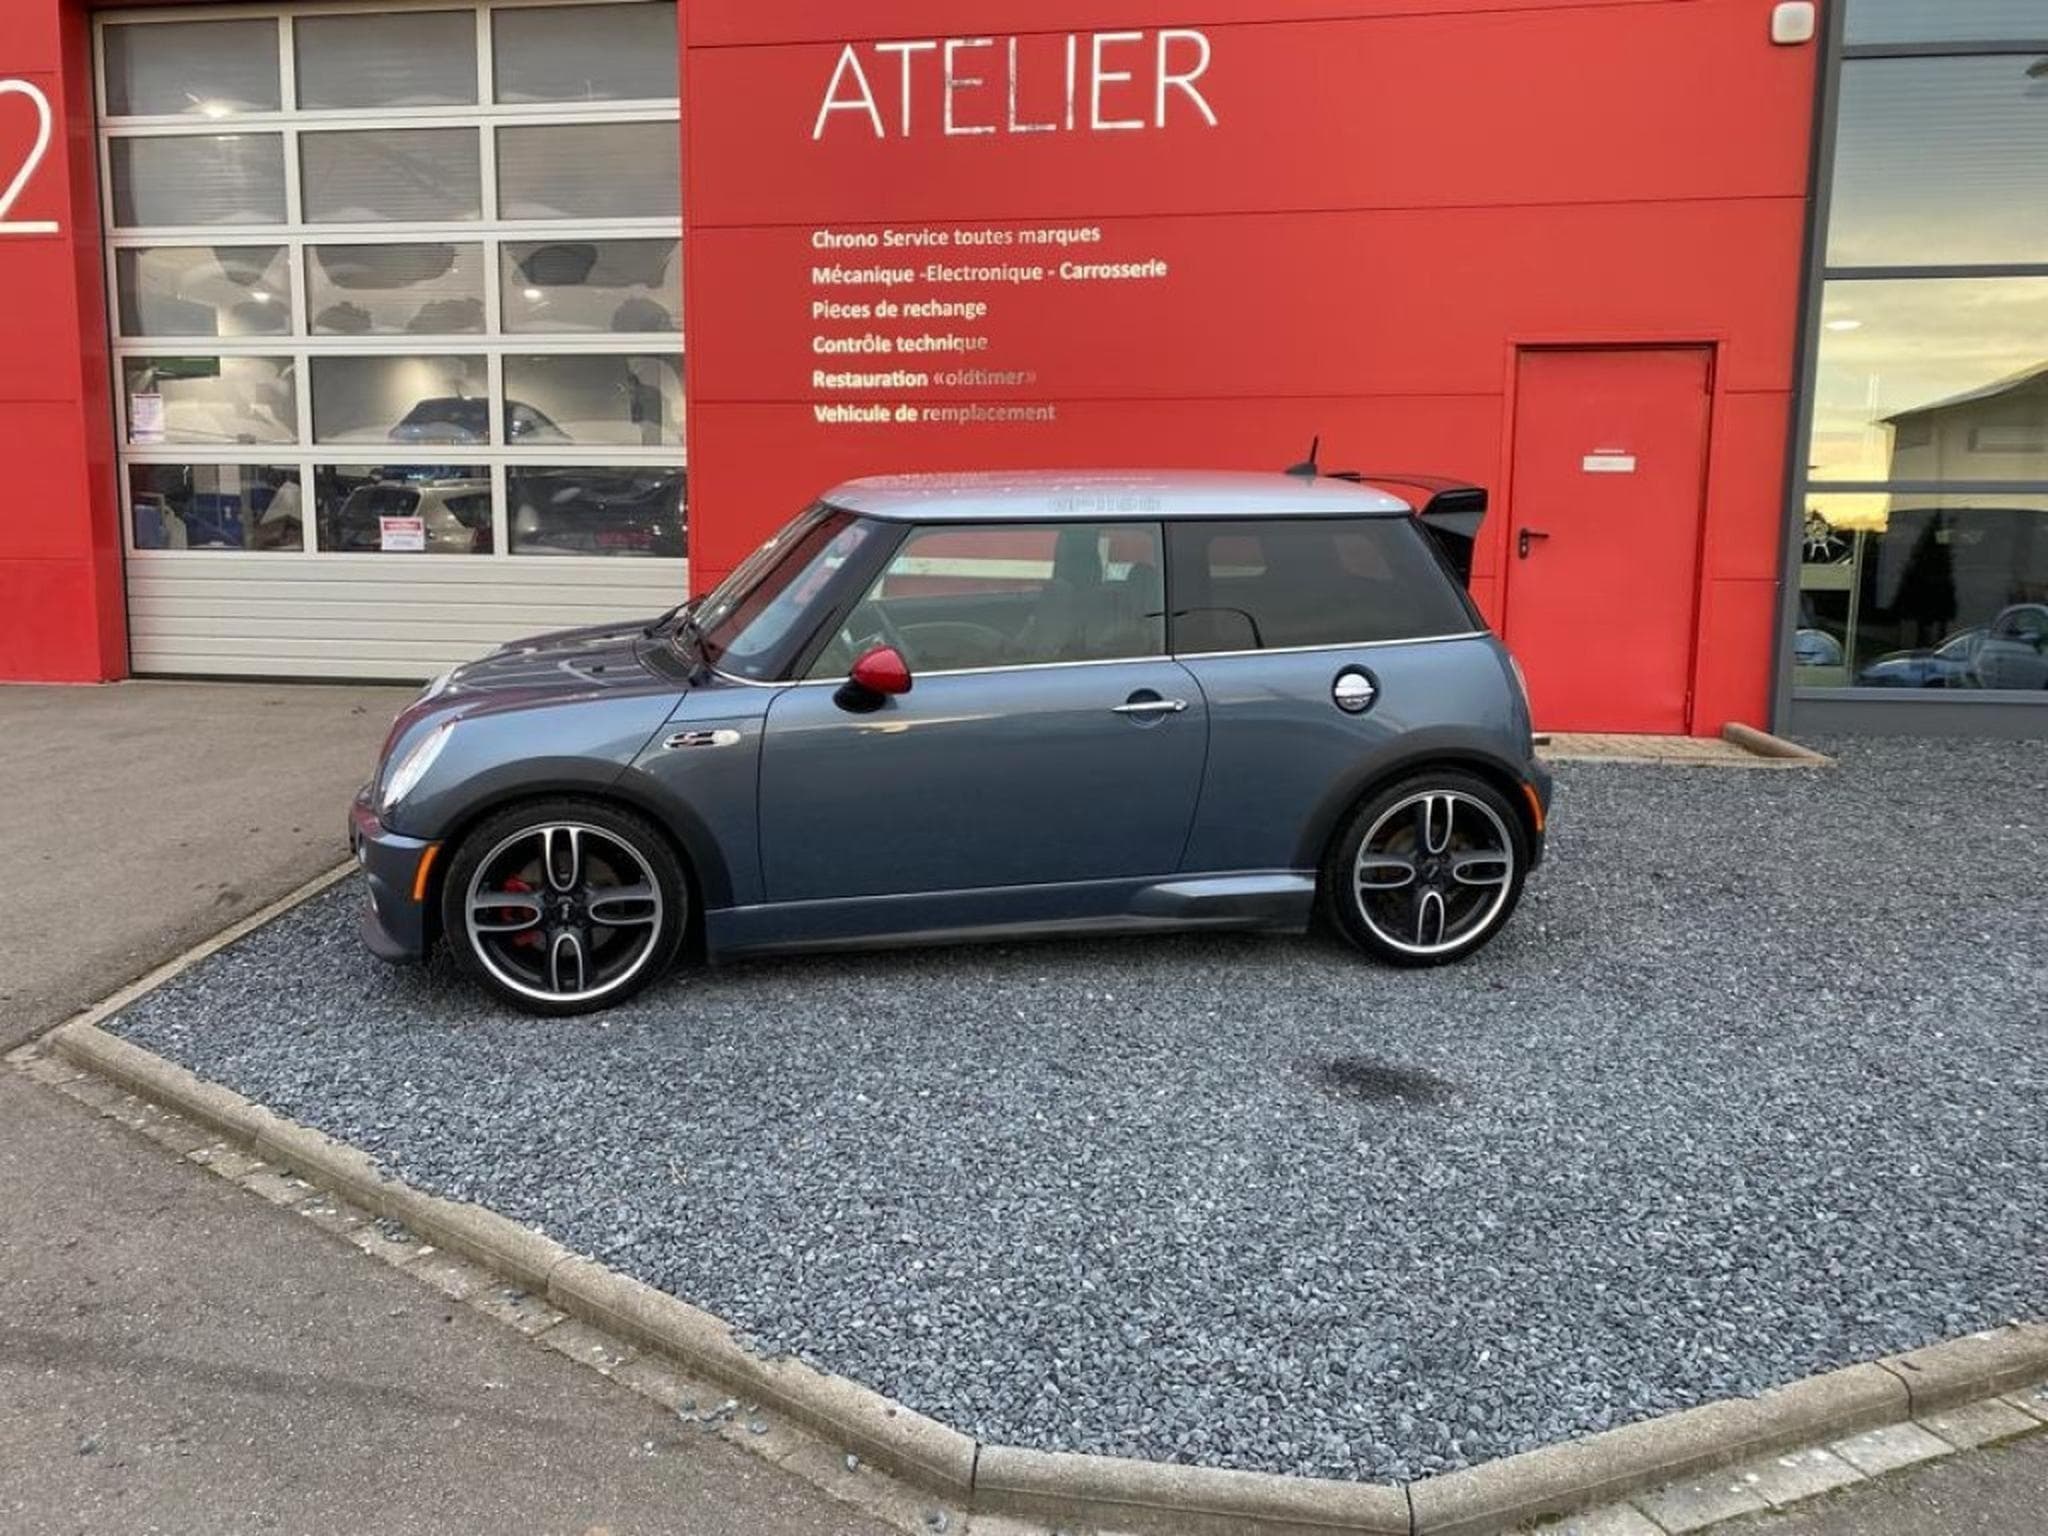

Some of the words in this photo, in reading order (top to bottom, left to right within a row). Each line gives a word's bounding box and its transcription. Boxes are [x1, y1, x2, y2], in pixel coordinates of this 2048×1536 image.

[812, 29, 1218, 140] ATELIER
[0, 79, 59, 233] 2
[811, 229, 879, 249] Chrono
[882, 227, 949, 247] Service
[953, 227, 1013, 246] toutes
[1018, 226, 1101, 247] marques
[811, 263, 915, 287] Mécanique
[1059, 258, 1168, 281] Carrosserie
[811, 299, 871, 320] Pieces
[874, 299, 899, 318] de
[902, 299, 987, 320] rechange
[812, 333, 893, 355] Contrôle
[896, 333, 988, 354] technique
[812, 369, 929, 389] Restauration
[813, 404, 891, 423] Vehicule
[894, 404, 918, 423] de
[922, 404, 1057, 425] remplacement
